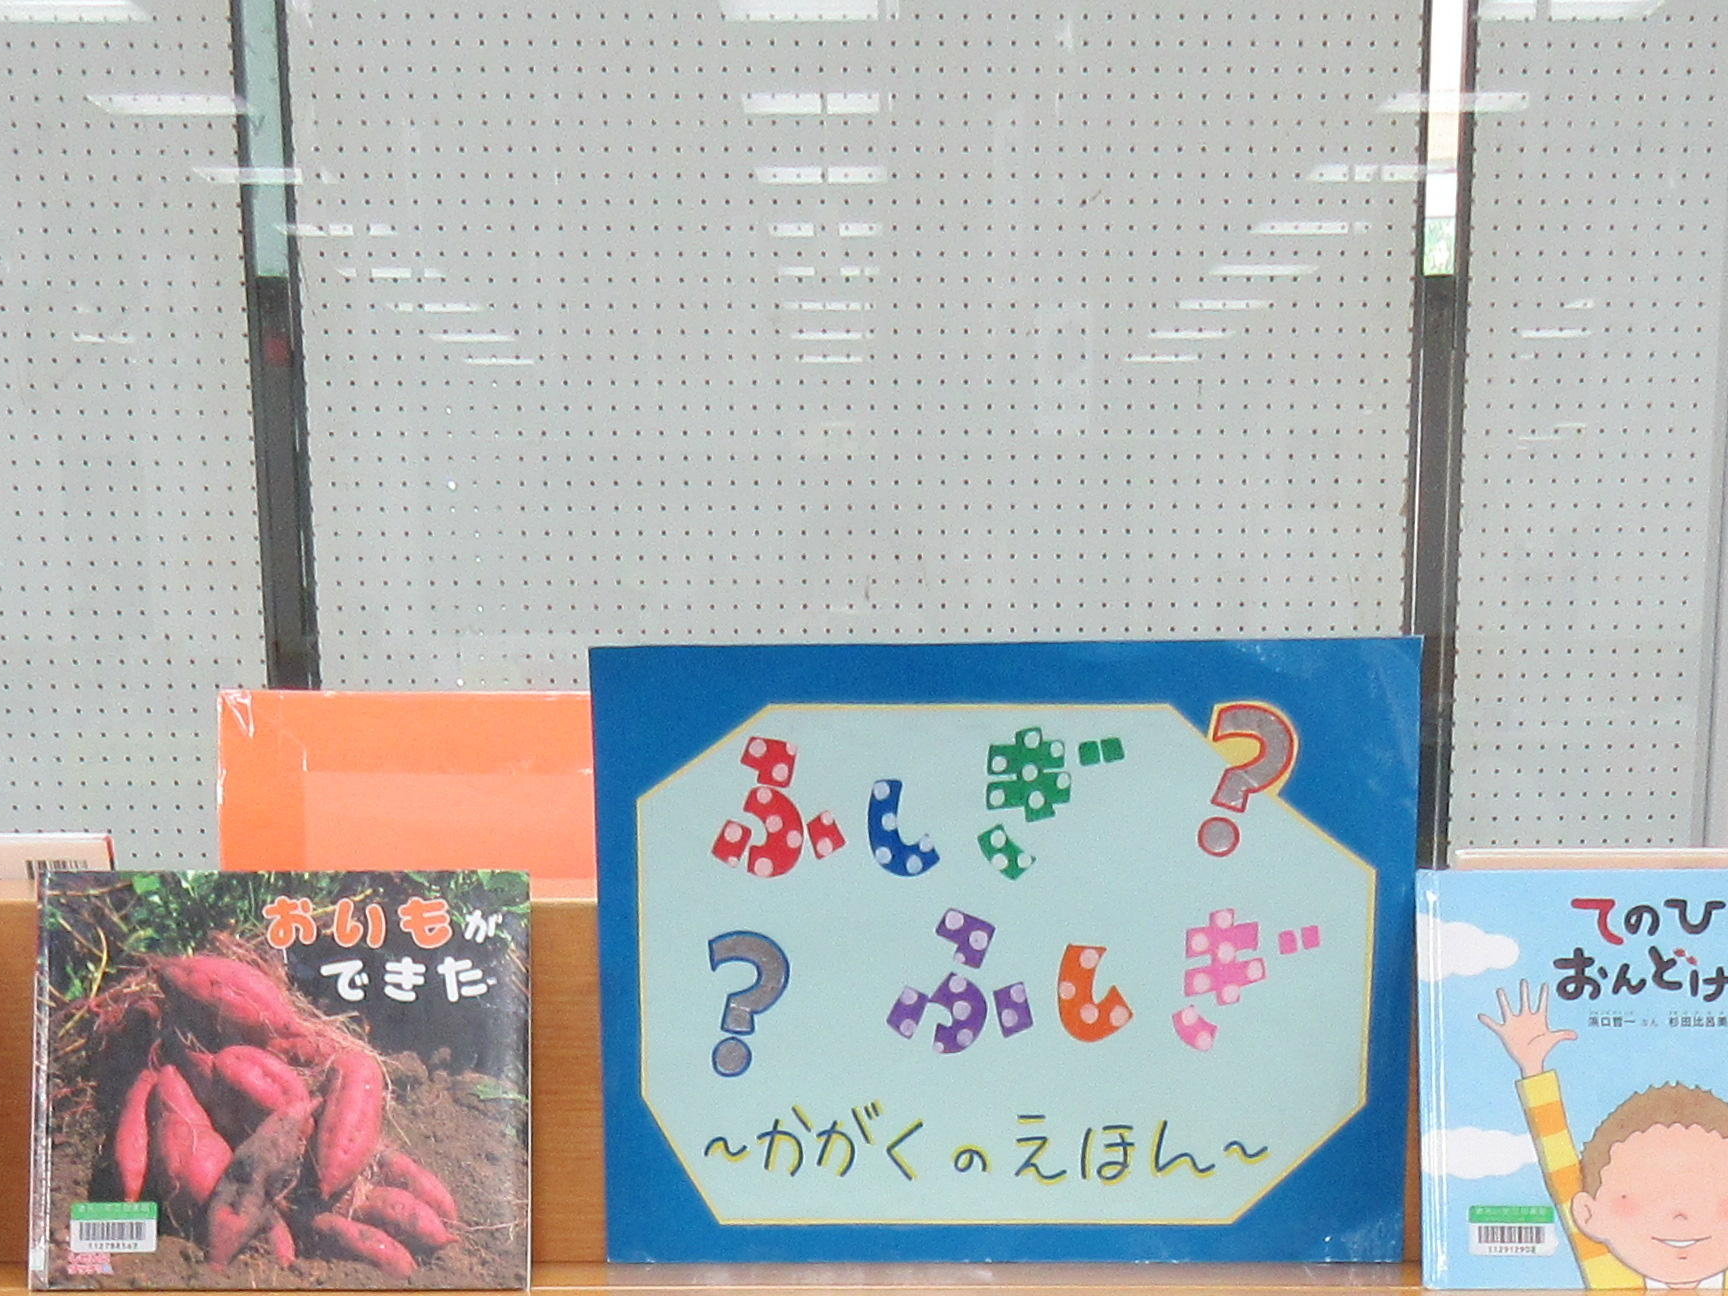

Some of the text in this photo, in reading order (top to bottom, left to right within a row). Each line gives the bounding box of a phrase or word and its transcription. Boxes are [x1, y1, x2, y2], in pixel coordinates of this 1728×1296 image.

[711, 703, 1298, 879] ふしぎ ?
[262, 895, 502, 949] おいもが
[320, 955, 498, 1002] できた
[708, 907, 1320, 1077] ? ふしぎ
